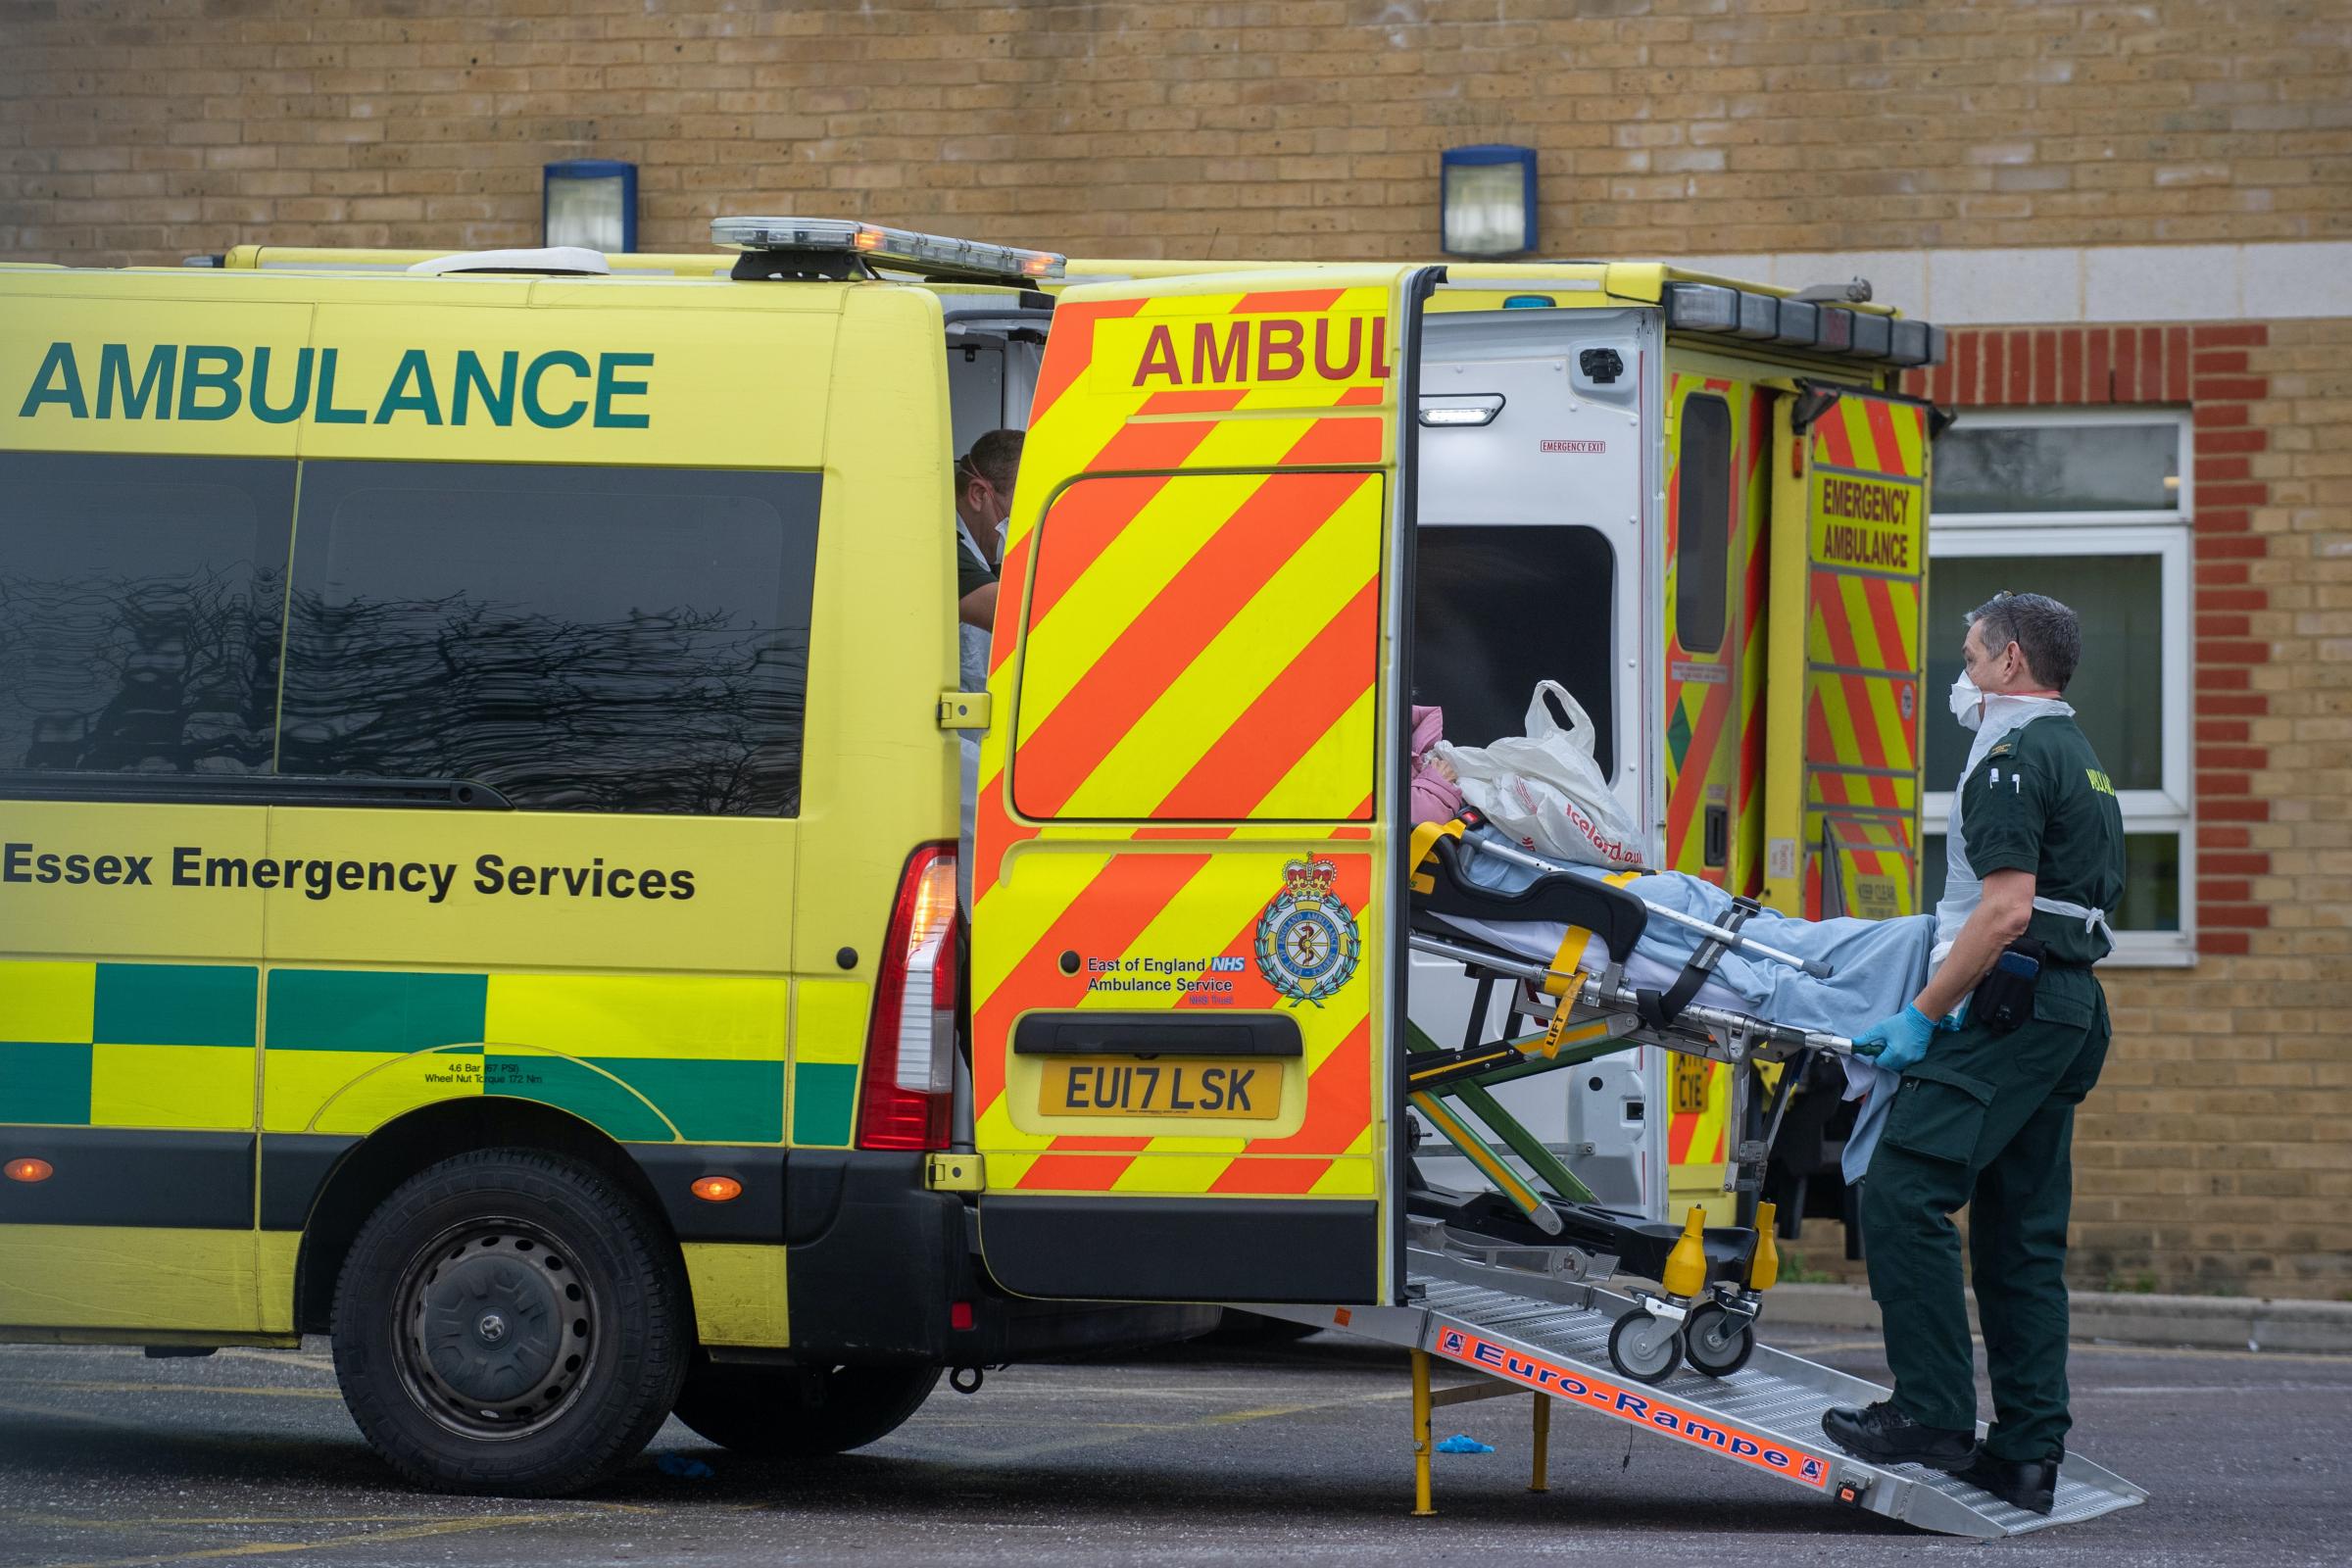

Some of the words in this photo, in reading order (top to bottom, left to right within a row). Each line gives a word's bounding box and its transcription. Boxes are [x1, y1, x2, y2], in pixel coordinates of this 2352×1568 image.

[1132, 317, 1390, 386] AMBUL
[19, 342, 655, 428] AMBULANCE
[1543, 442, 1586, 451] EMERGENCY
[1588, 443, 1604, 452] EXIT
[1824, 478, 1909, 525] EMERGENCY
[1824, 523, 1908, 567] AMBULANCE
[3, 843, 153, 885] Essex
[172, 847, 458, 904] Emergency
[473, 855, 696, 900] Services
[1278, 912, 1303, 942] ENGLAND
[1306, 912, 1339, 947] AMBULANCE
[1088, 957, 1119, 972] East
[1125, 957, 1140, 972] of
[1145, 957, 1205, 976] England
[1211, 956, 1246, 971] NHS
[1088, 978, 1171, 992] Ambulance
[1176, 979, 1233, 992] Service
[1545, 1014, 1564, 1047] LIFT
[424, 1074, 453, 1083] Wheel
[456, 1074, 472, 1083] Nut
[475, 1075, 505, 1085] Torque
[448, 1063, 463, 1072] 4.6
[1066, 1066, 1160, 1109] EU17
[1170, 1067, 1255, 1111] LSK
[1474, 1341, 1789, 1468] Euro-Rampe
